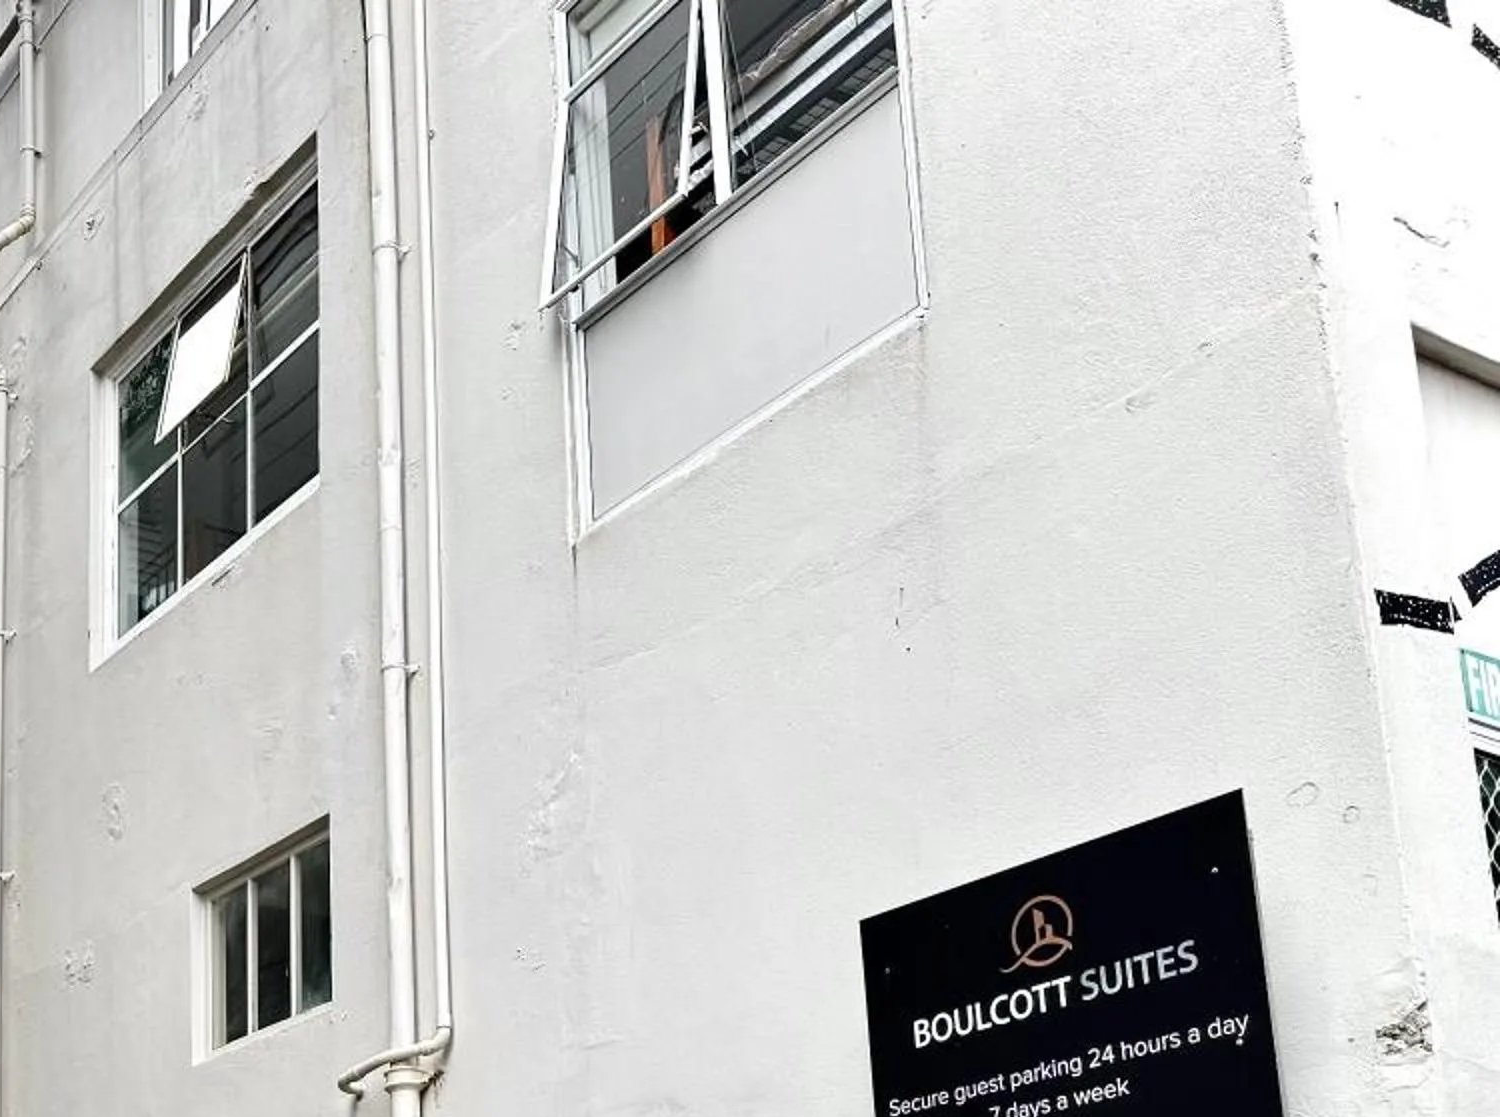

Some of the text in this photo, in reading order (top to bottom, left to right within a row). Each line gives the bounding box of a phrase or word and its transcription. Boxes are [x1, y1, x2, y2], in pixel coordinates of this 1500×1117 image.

[913, 939, 1200, 1049] BOULCOTT SUITES
[889, 1013, 1249, 1117] Secure guest parking 24 hours a day
[1056, 1094, 1069, 1110] a
[1073, 1077, 1131, 1108] week
